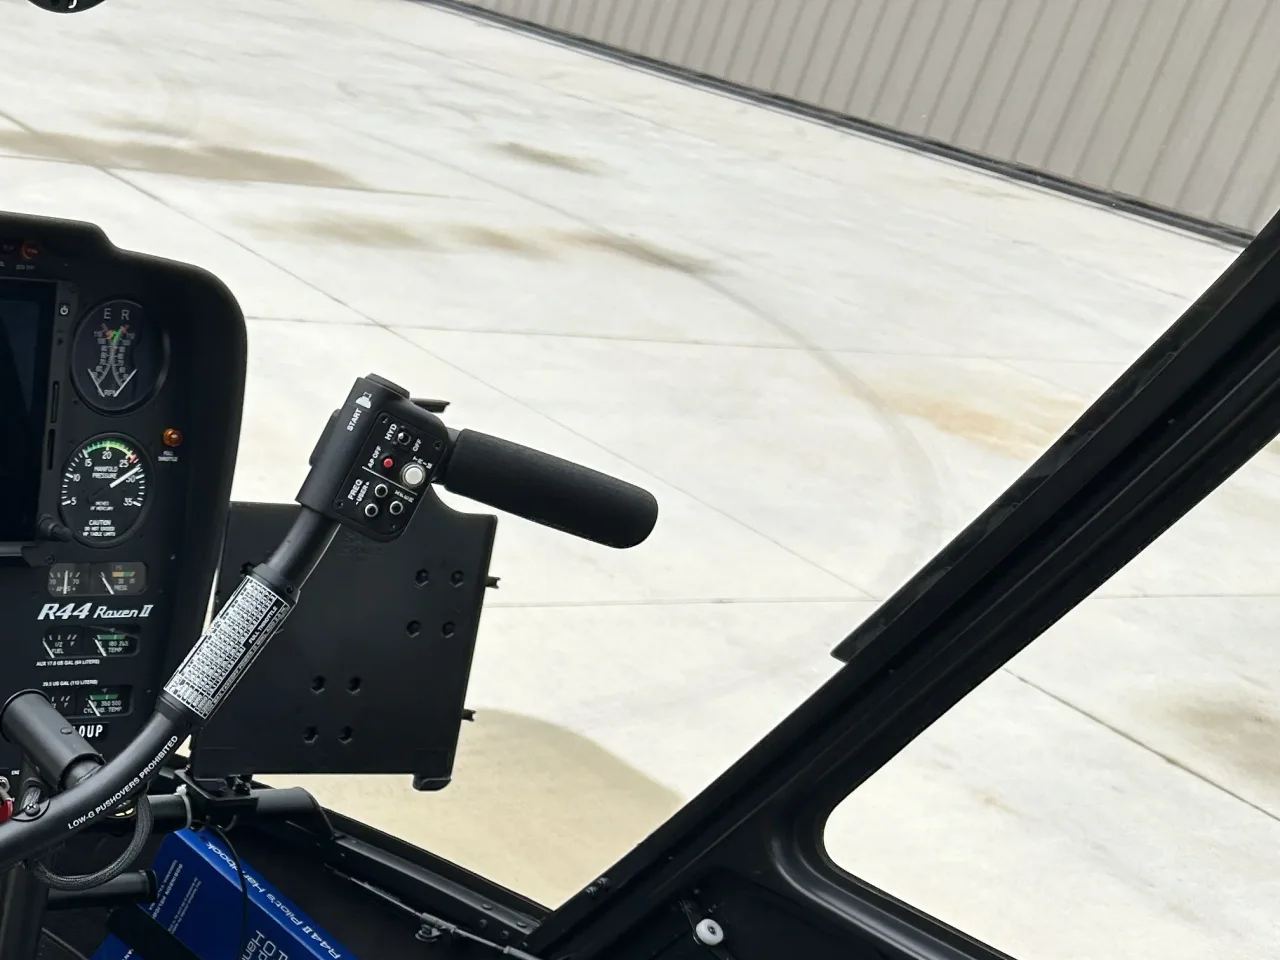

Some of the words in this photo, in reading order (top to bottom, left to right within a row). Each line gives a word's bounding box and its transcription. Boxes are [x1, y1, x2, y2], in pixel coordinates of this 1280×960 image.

[104, 308, 112, 319] E
[121, 309, 130, 320] R
[346, 408, 362, 432] START
[384, 423, 398, 441] HYD
[412, 438, 422, 452] OFF
[102, 451, 112, 460] 20
[367, 458, 376, 469] AP
[372, 445, 382, 459] OFF
[85, 459, 92, 467] 15
[119, 459, 129, 468] 25
[73, 473, 81, 481] 10
[347, 479, 363, 501] FREQ
[71, 497, 77, 505] 5
[123, 498, 133, 506] 35
[37, 602, 93, 620] R44
[93, 605, 139, 619] Raven
[139, 604, 154, 617] II
[67, 811, 95, 830] LOW-G
[95, 777, 140, 815] PUSHOVERS
[139, 735, 179, 779] PROHIBITED
[266, 893, 303, 927] Pilot's
[301, 924, 315, 936] II
[312, 931, 342, 960] R44
